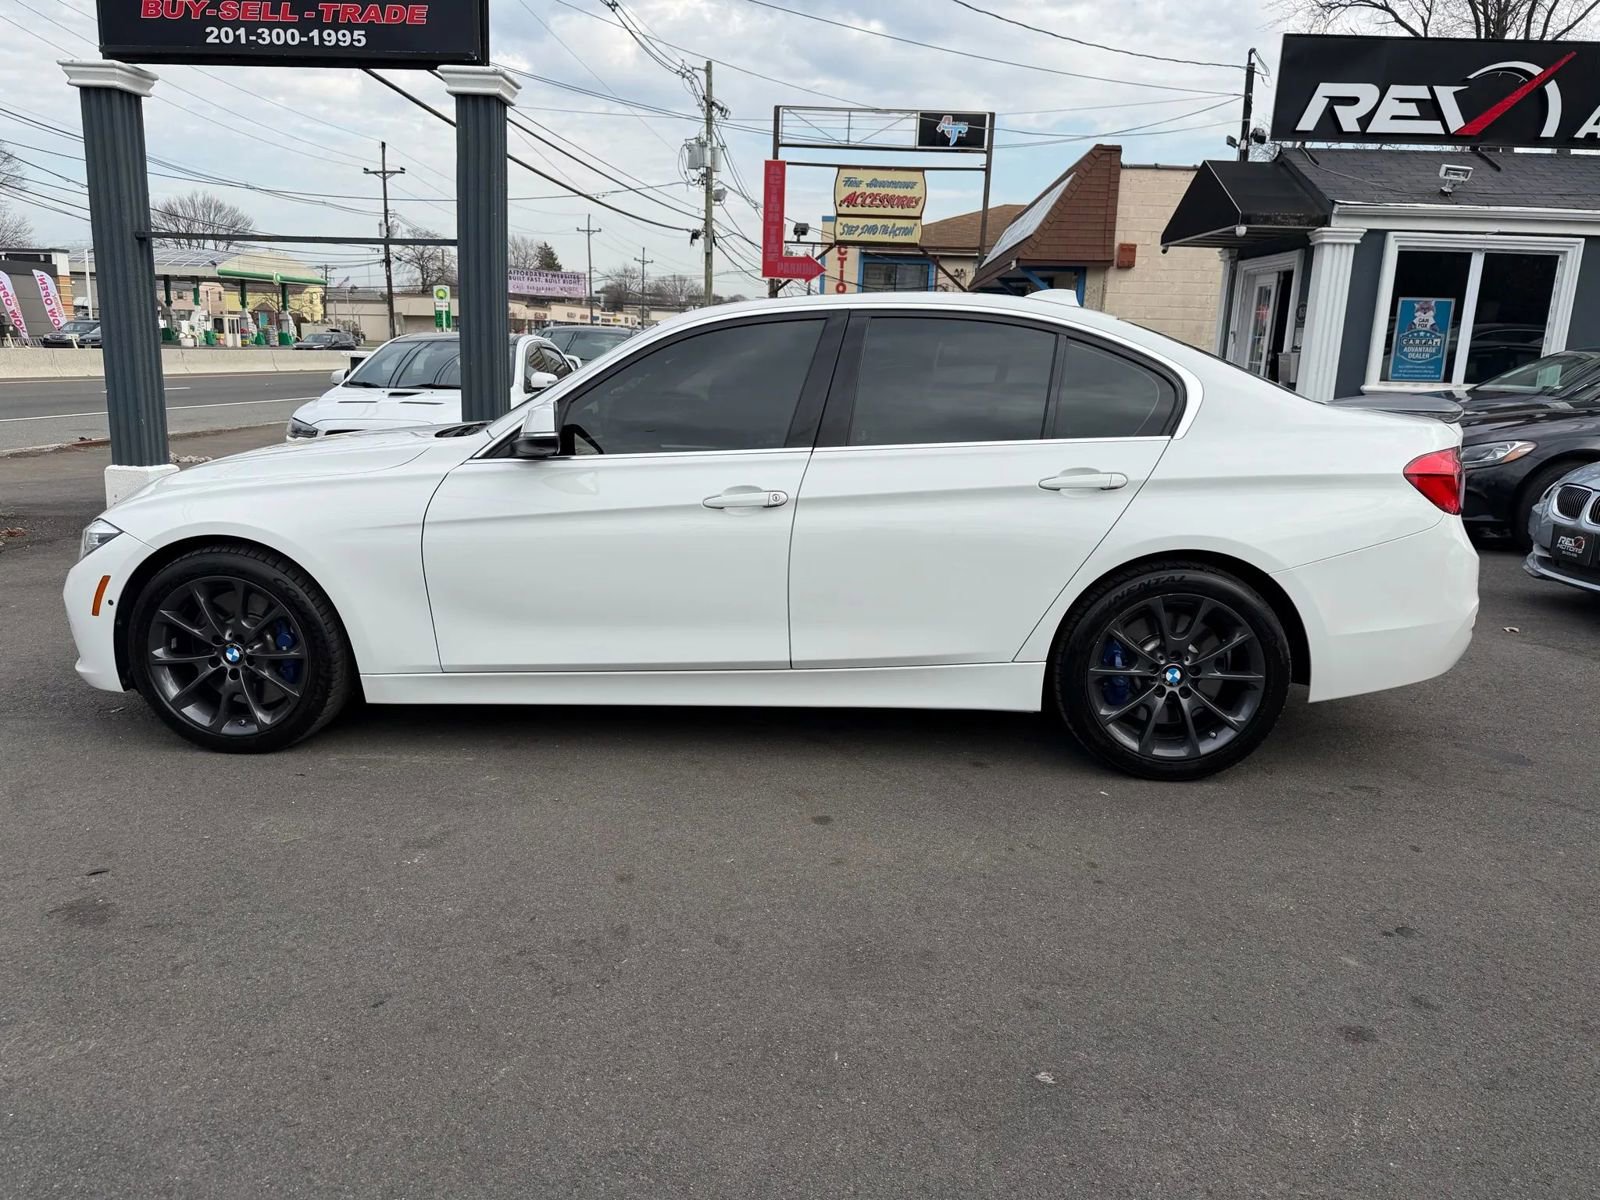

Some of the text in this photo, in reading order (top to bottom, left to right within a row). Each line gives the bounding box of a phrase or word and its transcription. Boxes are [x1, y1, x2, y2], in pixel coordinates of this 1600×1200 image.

[205, 26, 367, 47] 201-300-1995
[839, 190, 922, 209] ACCESSORIES
[508, 269, 549, 278] AFFORDABLE
